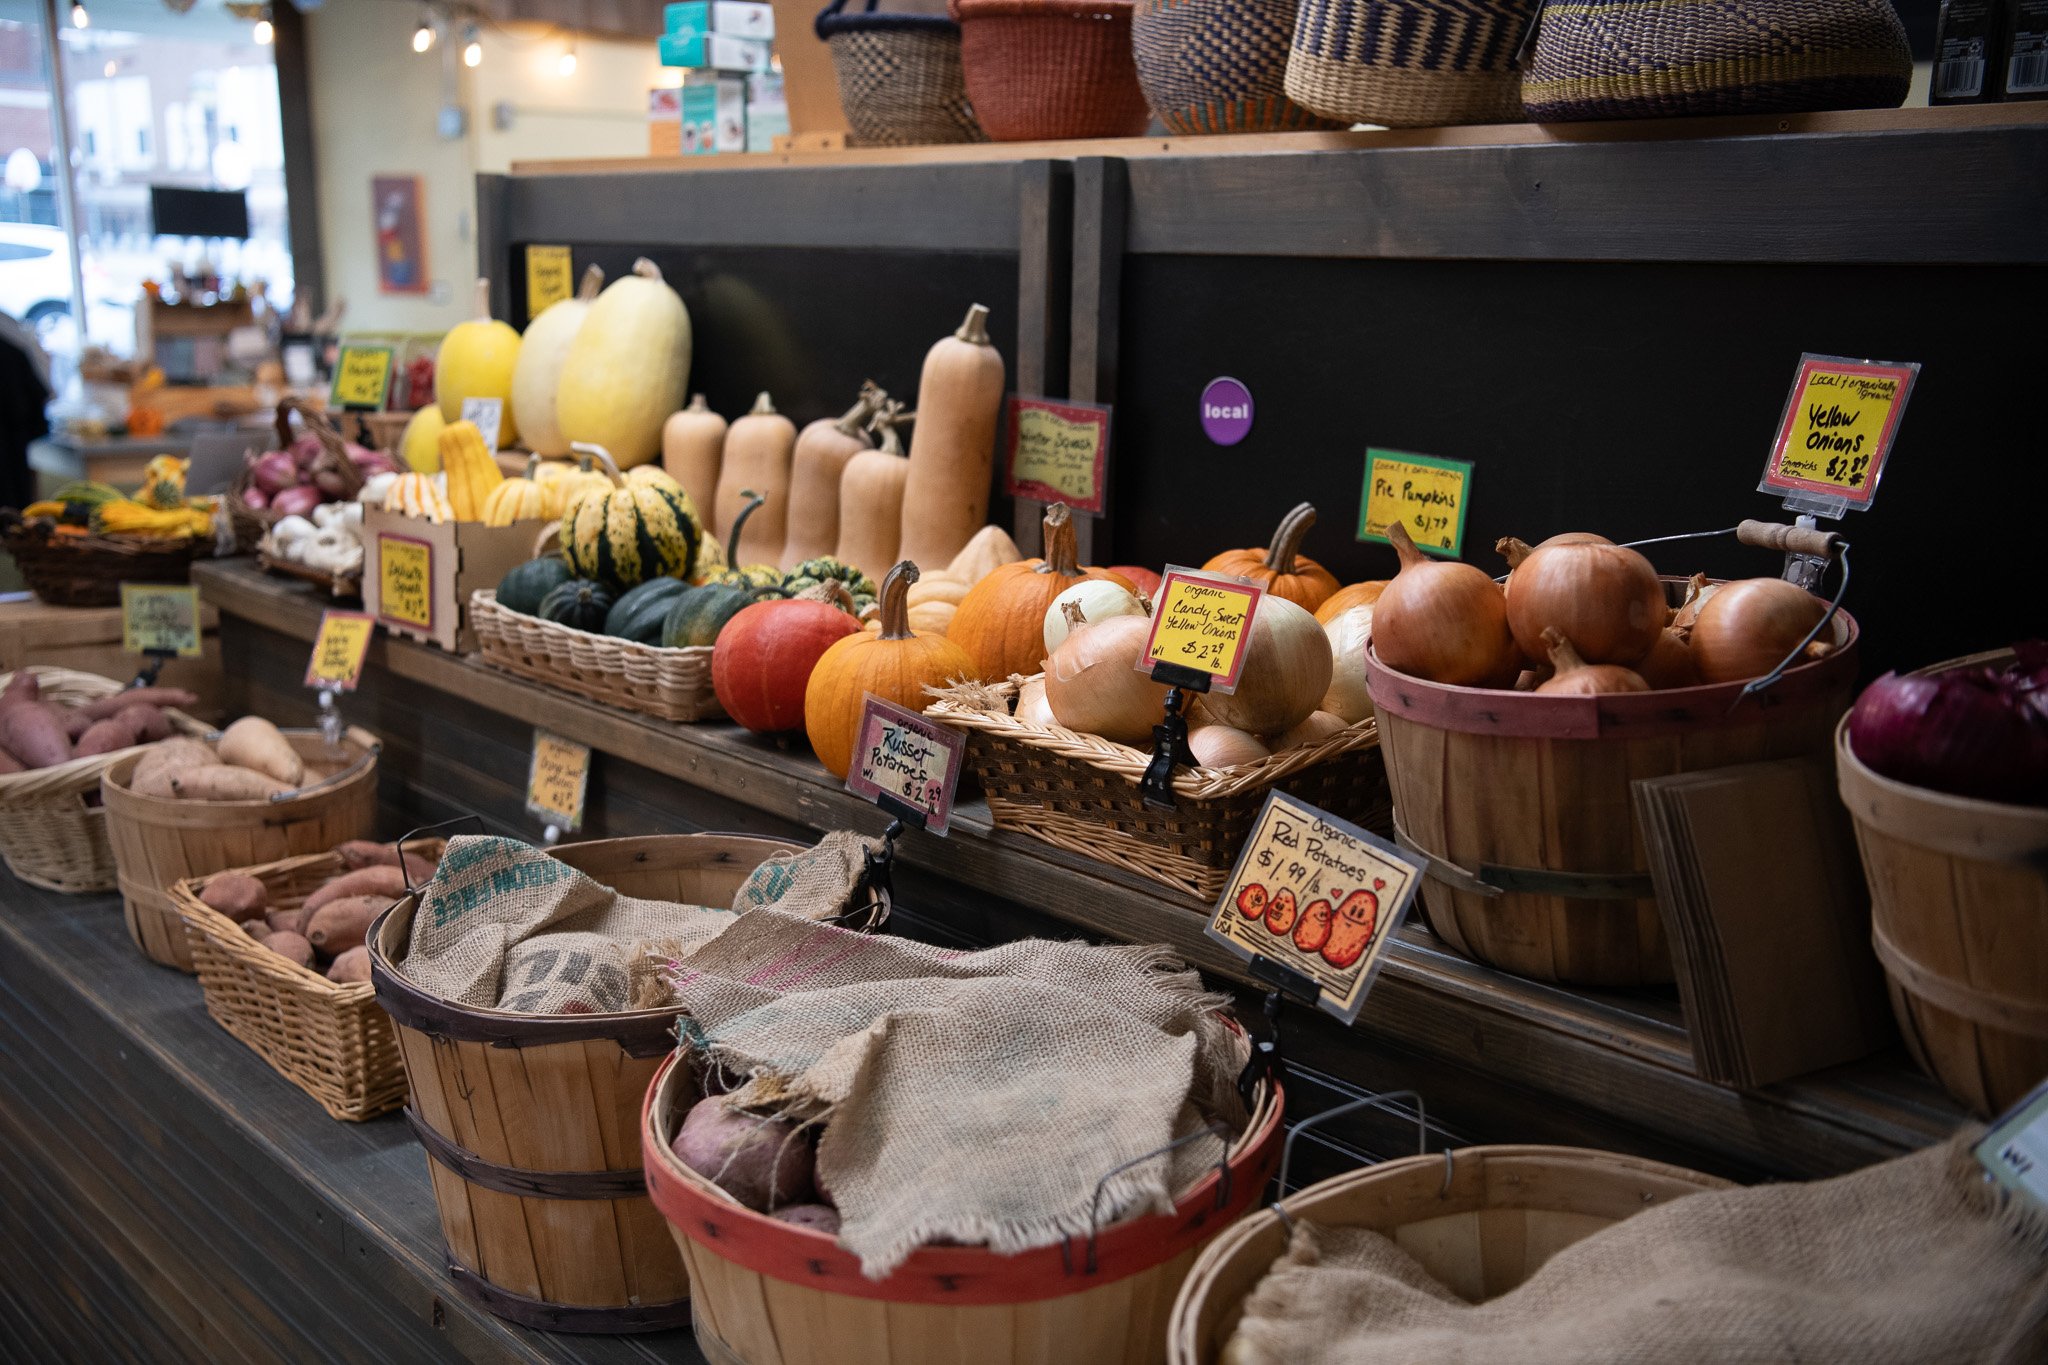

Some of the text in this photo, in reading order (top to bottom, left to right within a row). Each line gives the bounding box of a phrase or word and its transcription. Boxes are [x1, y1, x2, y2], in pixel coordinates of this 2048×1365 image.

[1205, 403, 1248, 419] local
[1809, 403, 1860, 430] Yellow
[1806, 431, 1864, 455] Onions
[1375, 478, 1455, 508] Pie Pumpkins
[1172, 599, 1247, 626] Candy Sweet
[1165, 615, 1237, 641] Yellow Onions
[882, 727, 935, 768] Russet
[871, 747, 928, 784] Potatoes
[1311, 817, 1358, 850] Organic
[1271, 820, 1368, 884] Red Potatoes
[1214, 918, 1233, 937] USA
